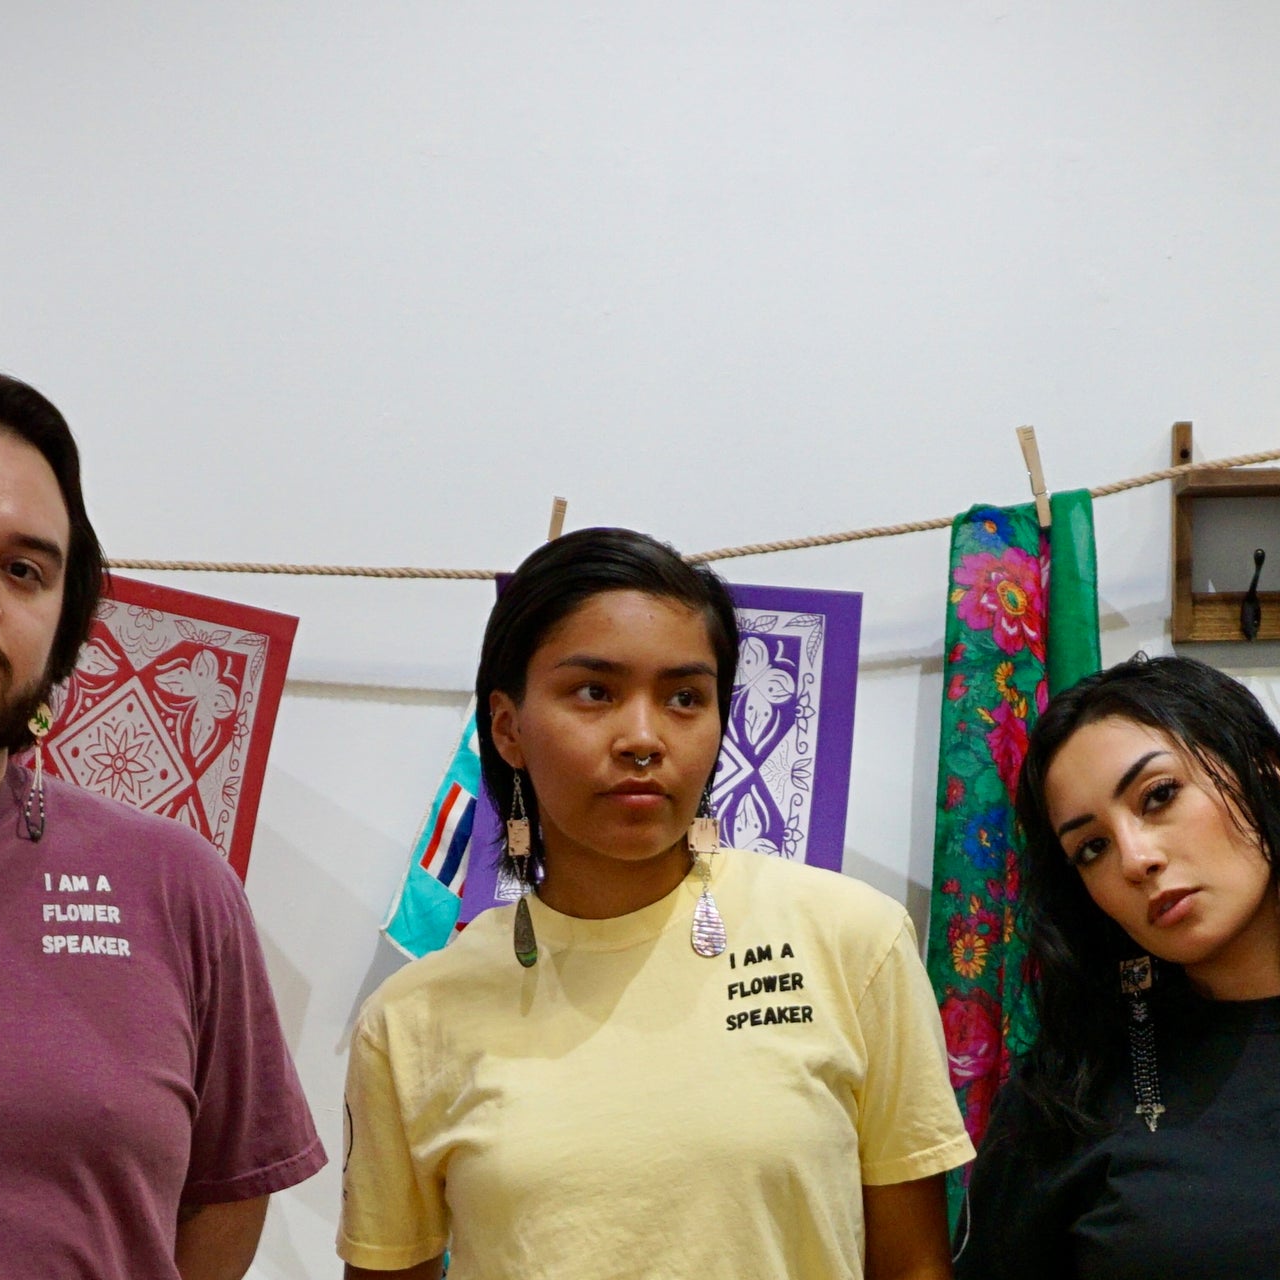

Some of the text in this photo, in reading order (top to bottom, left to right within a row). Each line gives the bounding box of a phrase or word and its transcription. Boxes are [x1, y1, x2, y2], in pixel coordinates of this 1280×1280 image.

[44, 873, 111, 892] I AM A
[42, 904, 121, 924] FLOWER
[41, 935, 131, 957] SPEAKER
[729, 943, 795, 969] I AM A
[727, 972, 804, 1000] FLOWER
[726, 1005, 813, 1031] SPEAKER
